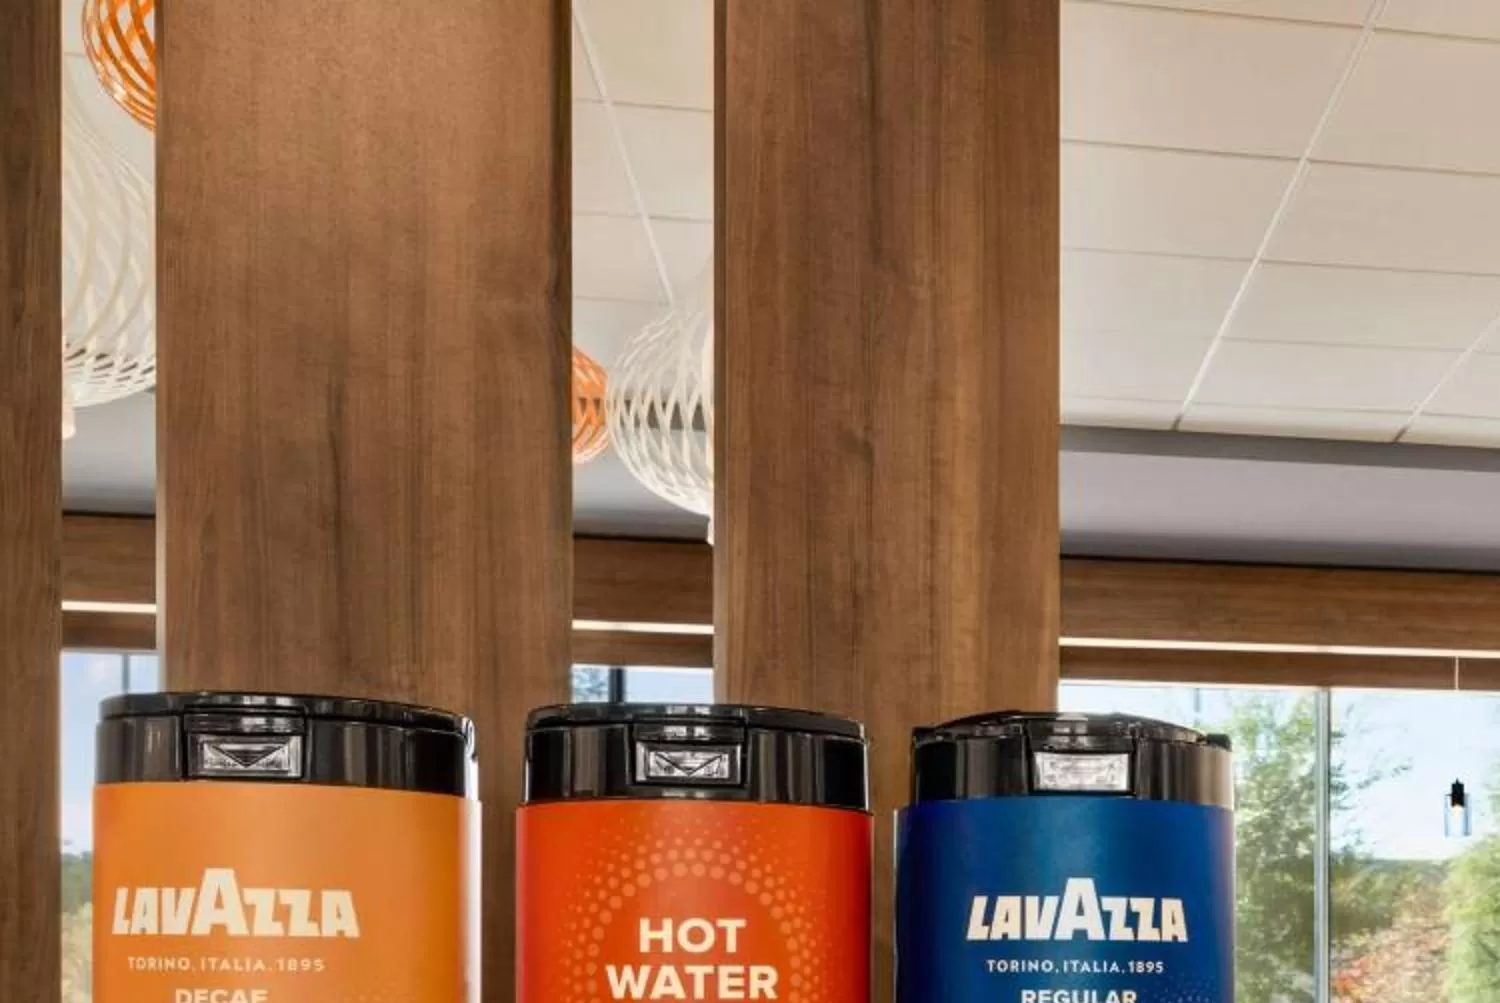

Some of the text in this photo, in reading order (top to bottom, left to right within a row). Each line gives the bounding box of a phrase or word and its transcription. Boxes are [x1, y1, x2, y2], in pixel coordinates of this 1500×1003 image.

[111, 868, 360, 937] LAVAZZA
[966, 877, 1189, 942] LAVAZZA
[639, 917, 747, 953] HOT
[278, 959, 325, 973] 1895
[605, 964, 779, 1000] WATER
[1128, 961, 1165, 974] 1895
